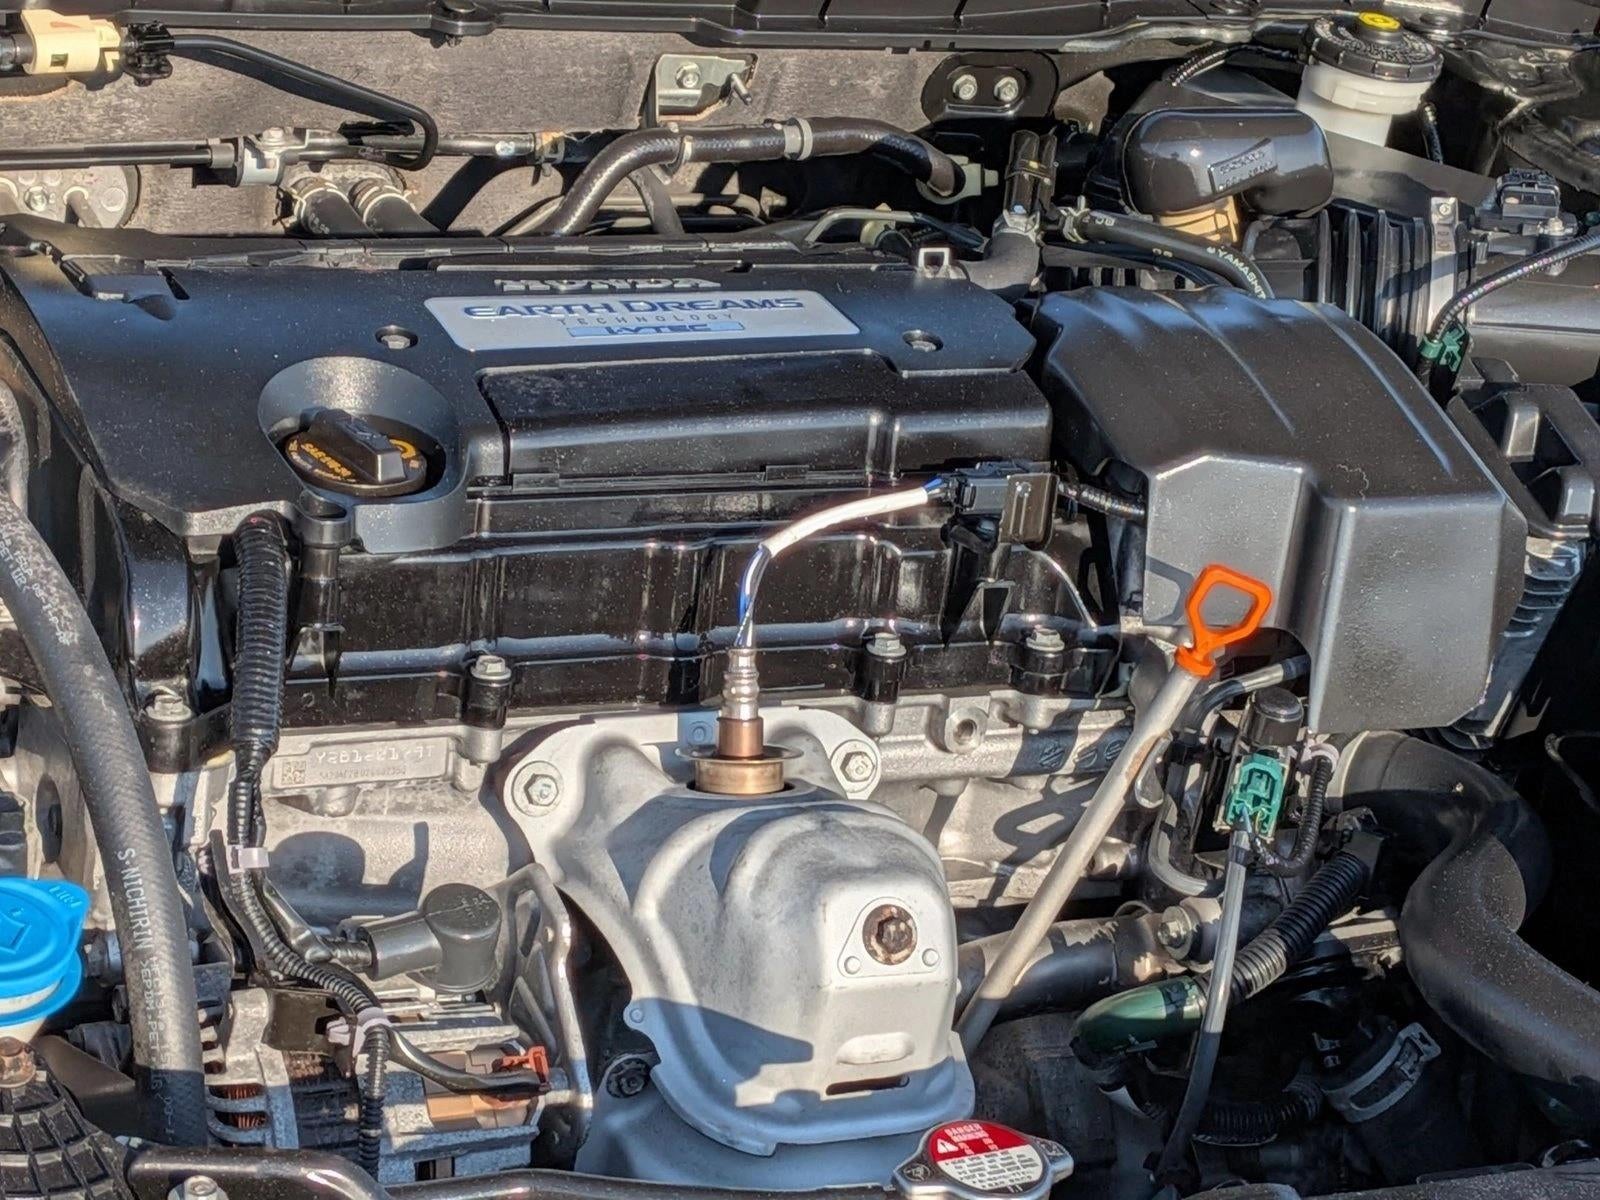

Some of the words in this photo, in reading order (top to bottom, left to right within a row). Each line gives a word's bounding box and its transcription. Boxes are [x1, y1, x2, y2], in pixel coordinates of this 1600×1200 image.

[494, 278, 721, 292] HONDA
[463, 303, 616, 318] EARTH
[622, 298, 804, 313] DREAMS
[557, 313, 734, 327] TECHNOLOGY
